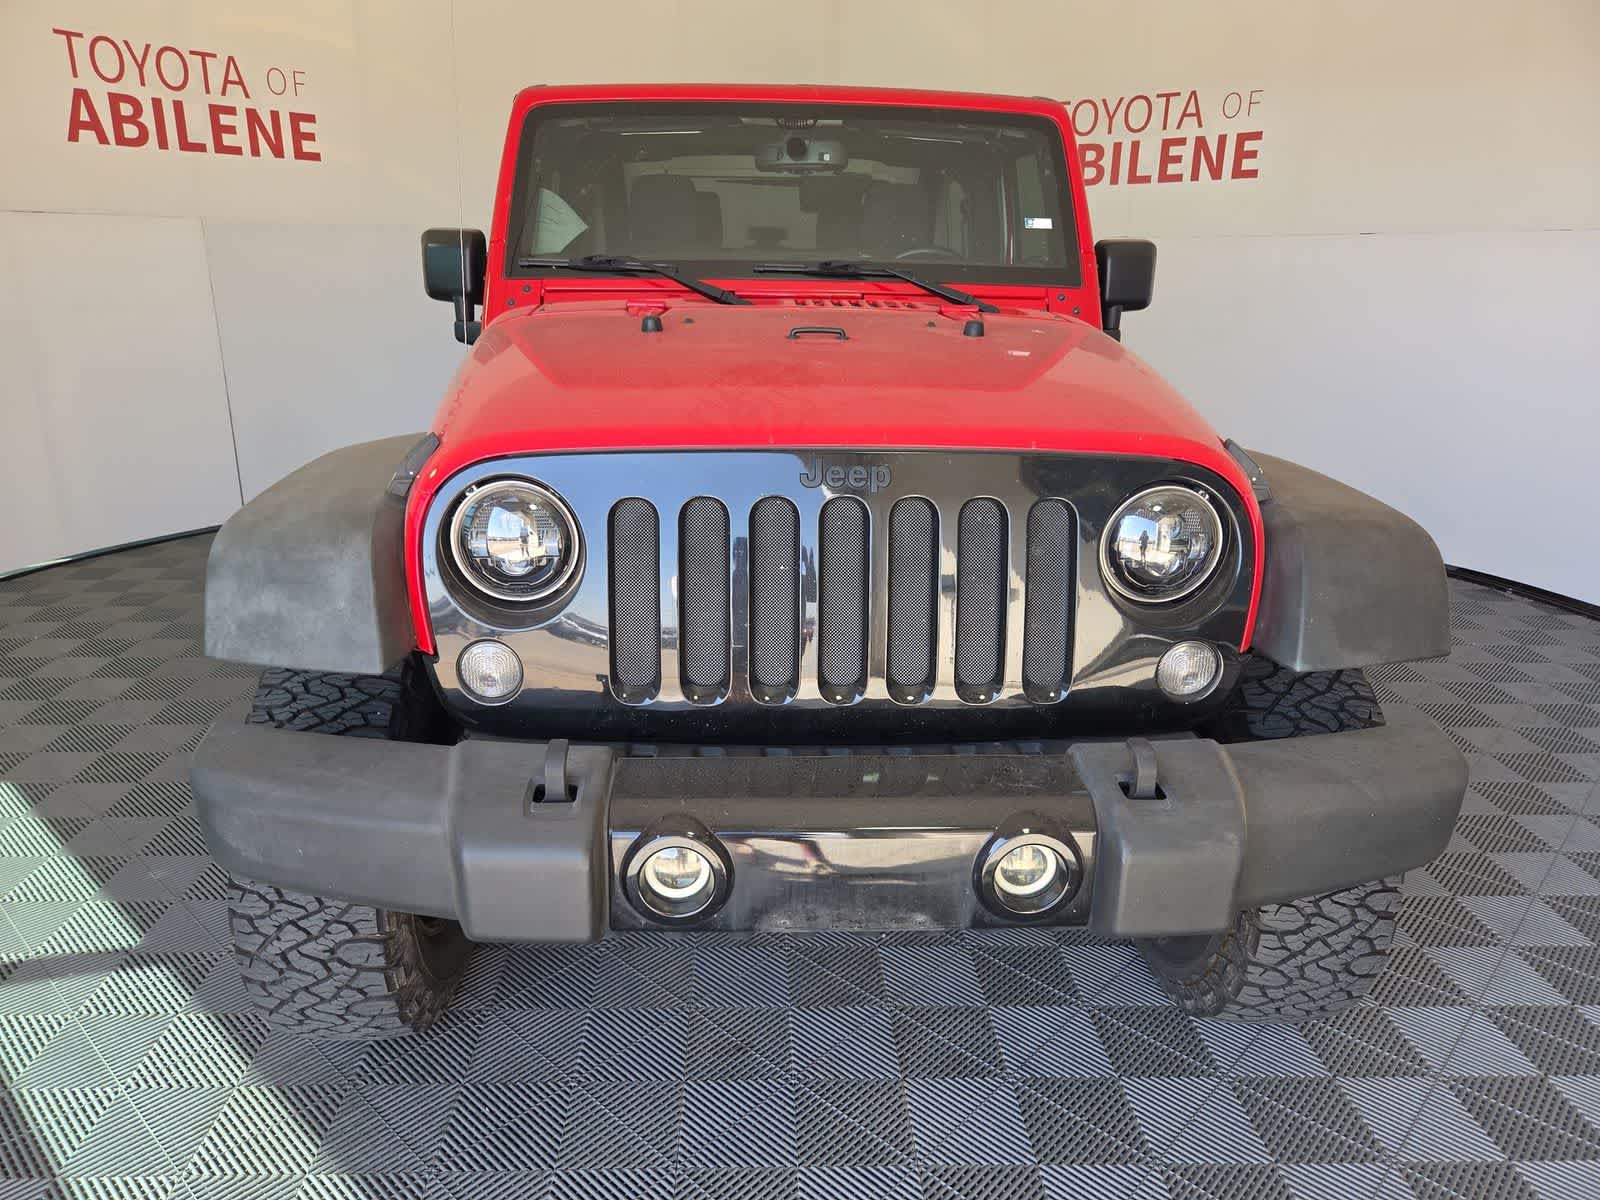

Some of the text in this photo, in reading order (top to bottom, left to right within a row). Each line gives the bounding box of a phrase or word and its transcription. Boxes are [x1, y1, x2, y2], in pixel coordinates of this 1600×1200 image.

[52, 28, 306, 99] TOYOTA OF
[67, 87, 322, 162] ABILENE
[1061, 89, 1264, 137] OYOTA OF
[1077, 131, 1263, 186] BILENE
[799, 456, 892, 494] Jeep
